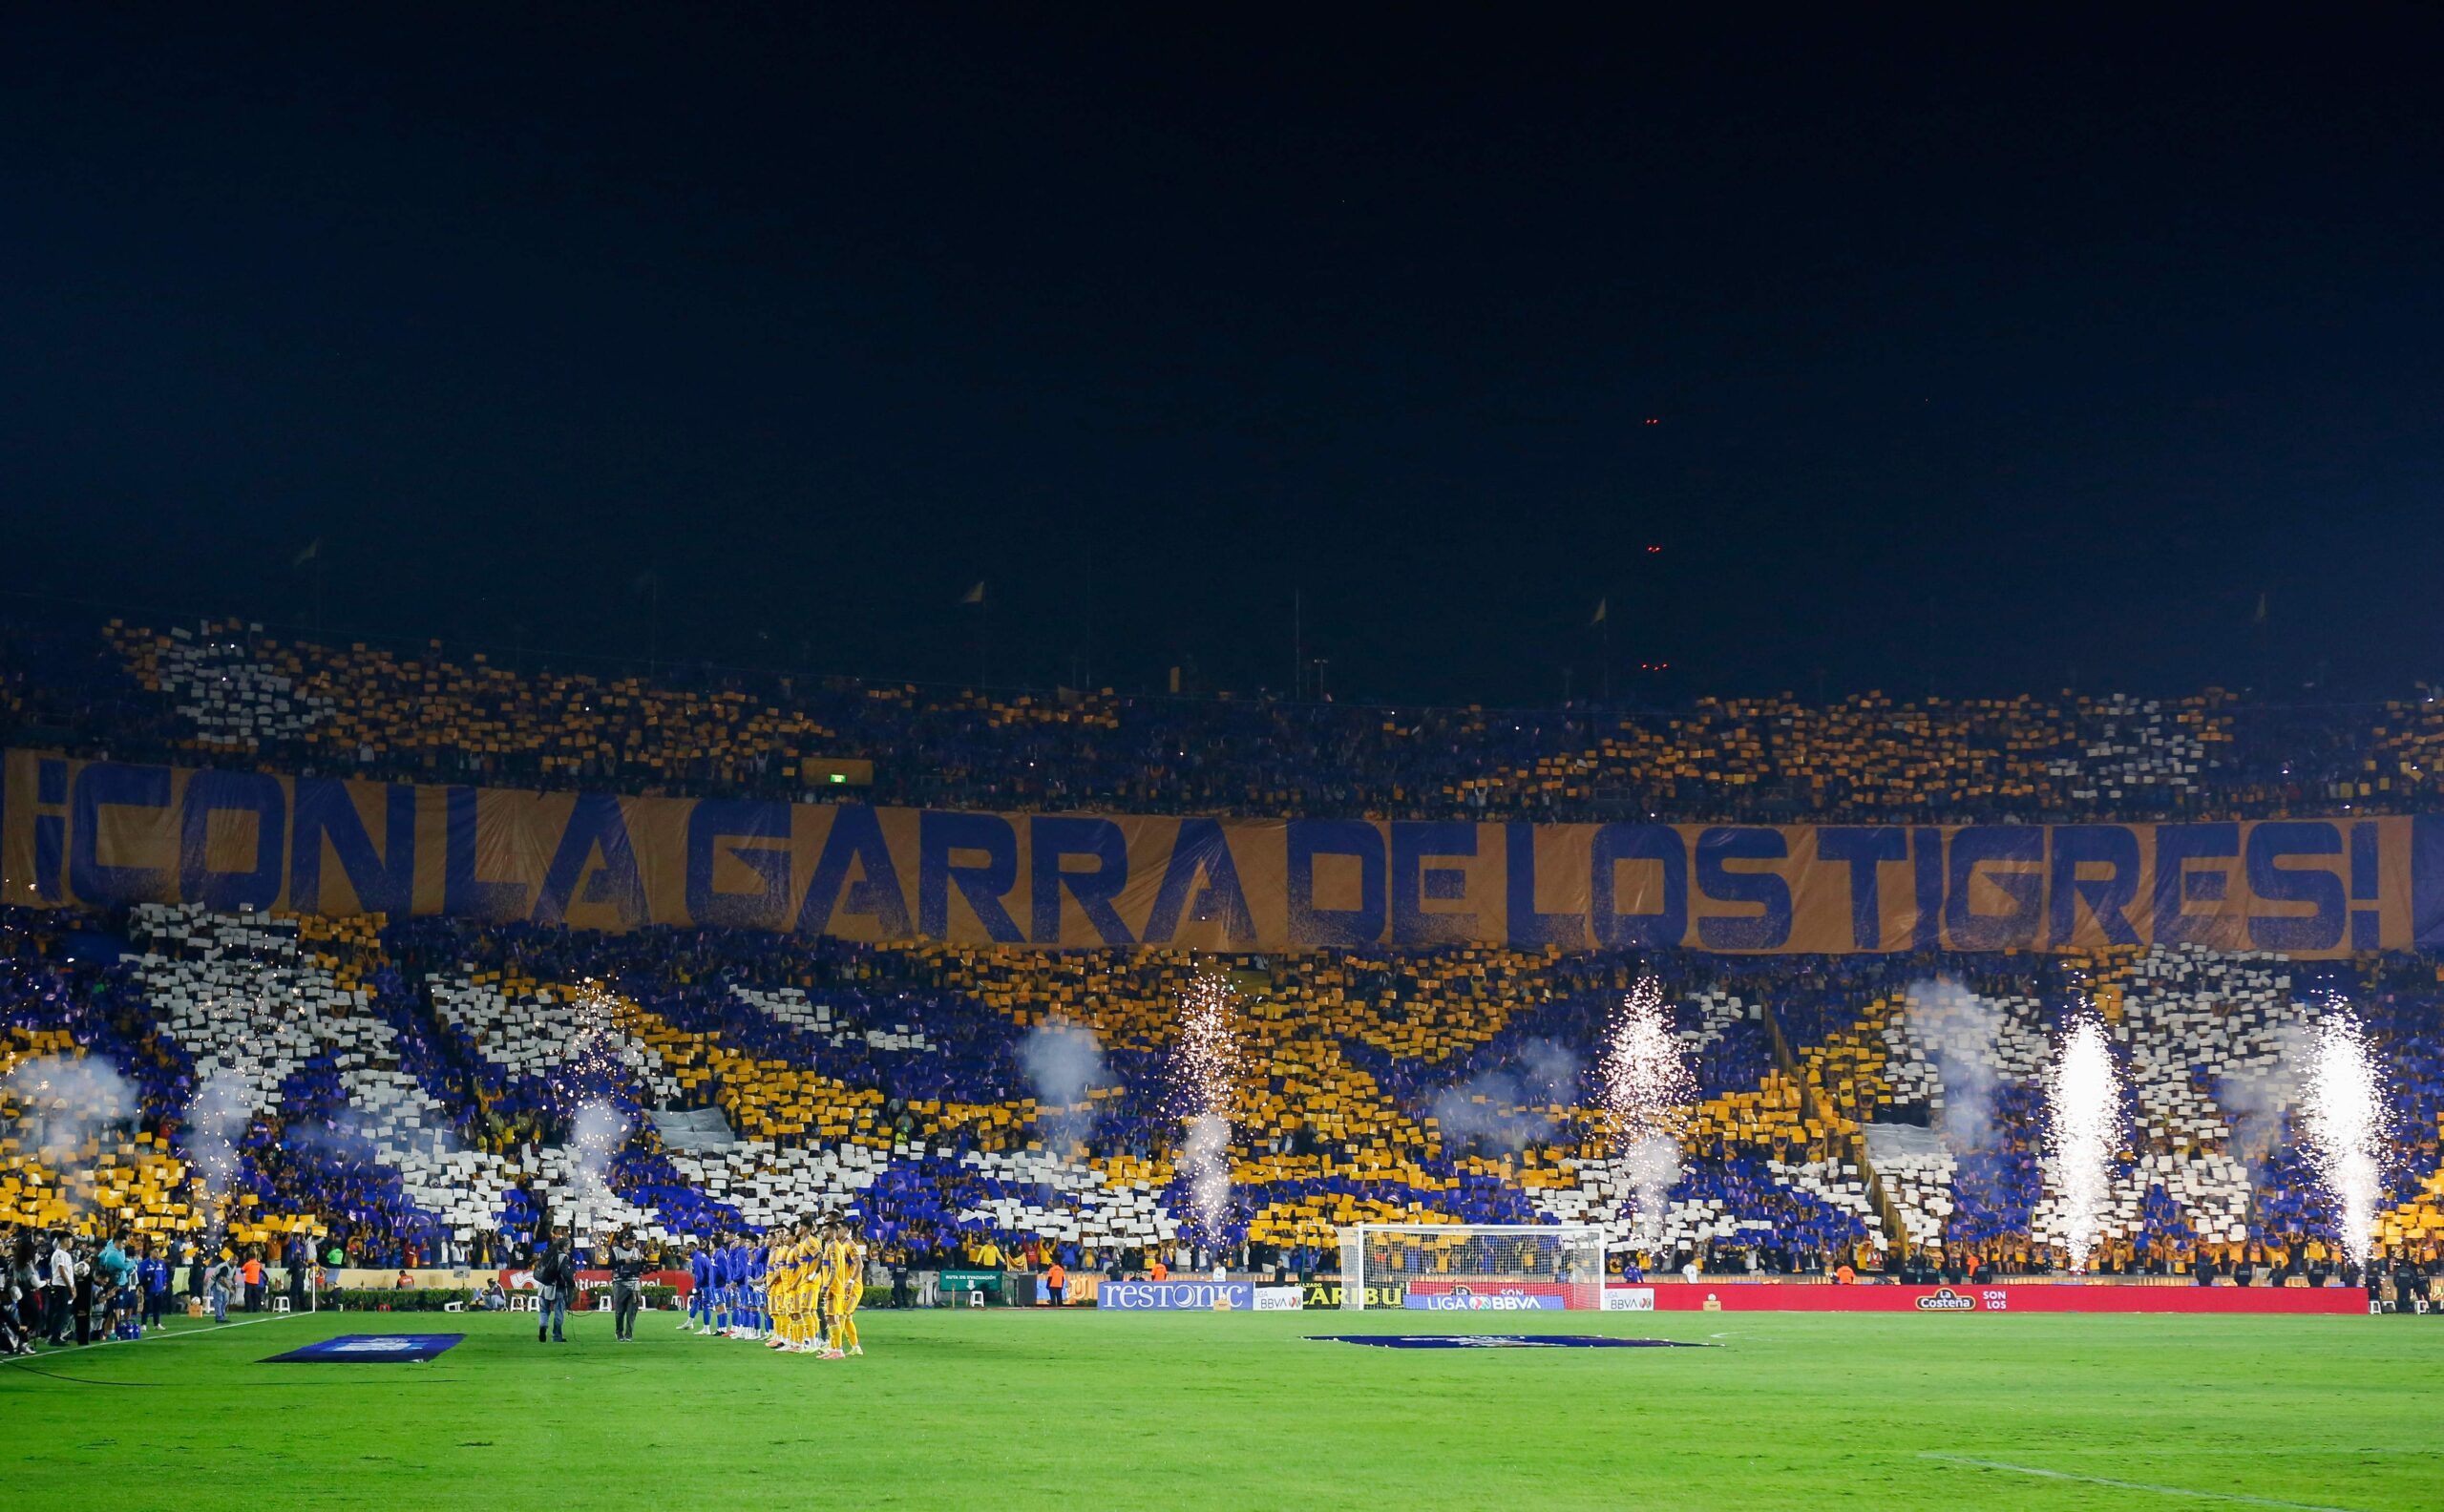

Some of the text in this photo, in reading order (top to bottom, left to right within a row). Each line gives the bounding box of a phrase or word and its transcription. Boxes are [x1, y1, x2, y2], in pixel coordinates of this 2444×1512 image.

[444, 784, 651, 929] LA
[685, 798, 1257, 945] GARRA
[1287, 819, 1479, 946] DE
[1506, 822, 1792, 951] LOS
[1816, 821, 2380, 952] TIGRES!
[1982, 1291, 2007, 1300] SON
[1260, 1297, 1287, 1309] BBVA
[1427, 1296, 1541, 1311] LIGA BBVA
[1611, 1298, 1638, 1310] BBVA
[1920, 1297, 1970, 1308] Costeña
[1987, 1300, 2007, 1310] LOS
